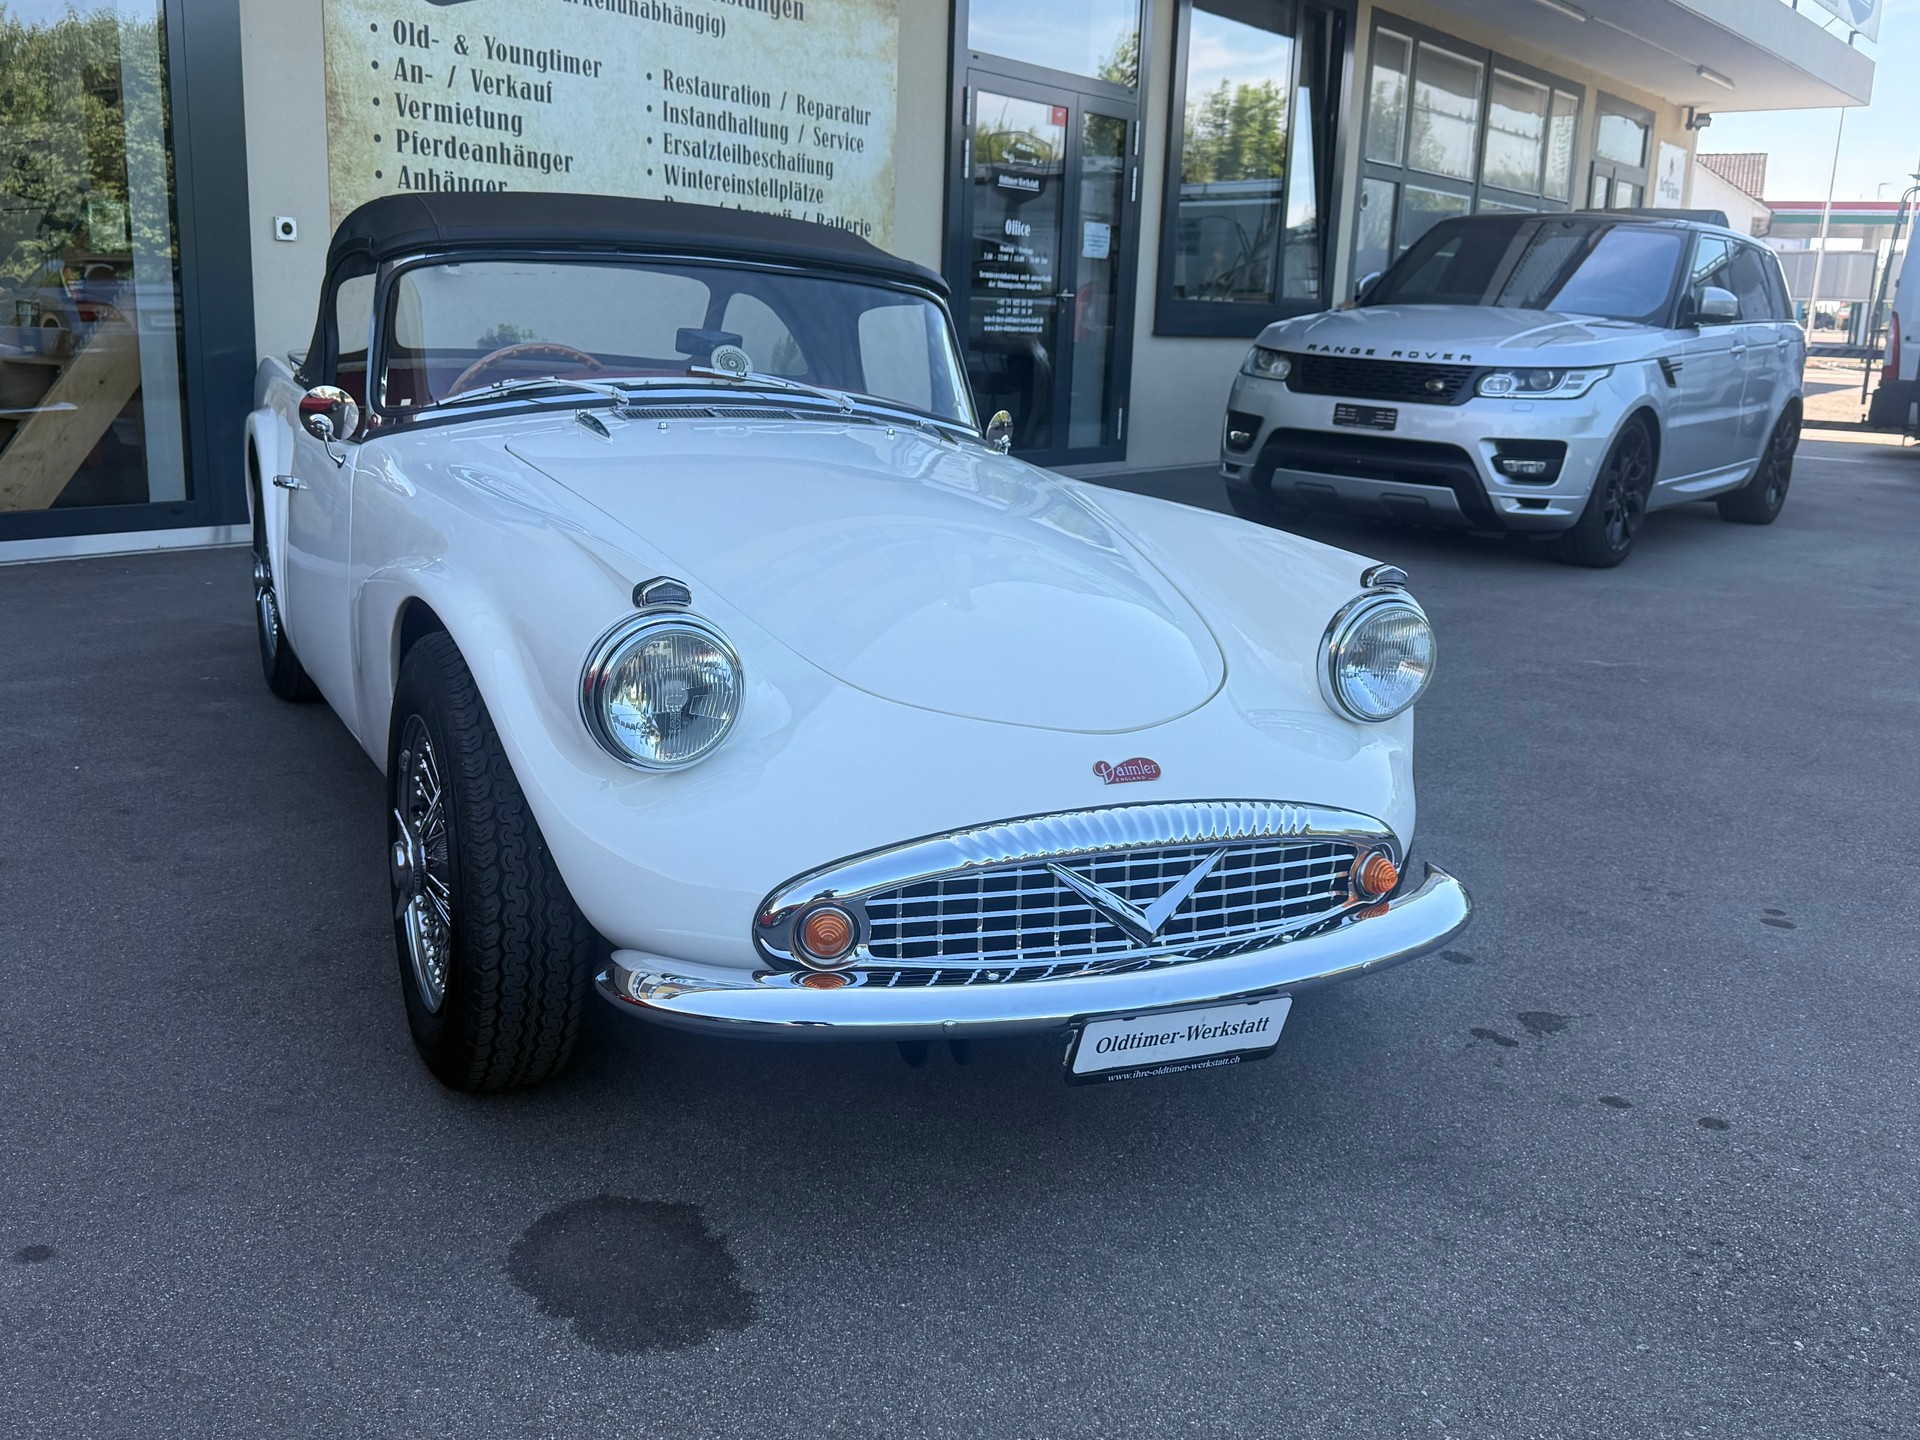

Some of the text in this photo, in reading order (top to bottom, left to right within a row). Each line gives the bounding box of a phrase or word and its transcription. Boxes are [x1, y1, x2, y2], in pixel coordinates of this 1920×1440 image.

[393, 19, 602, 79] Old- & Youngtimer
[394, 56, 553, 104] An- / Verkauf
[662, 68, 871, 126] Restauration / Reparatur
[394, 92, 523, 137] Vermietung
[662, 100, 864, 153] Instandhaltung / Service
[396, 128, 573, 174] Pferdeanhänger
[663, 132, 834, 181] Ersatzteilbeschaffung
[663, 163, 824, 204] Wintereinstellplätze
[1306, 343, 1472, 362] RANGE ROVER
[1094, 759, 1157, 784] Daimler
[1095, 1016, 1270, 1054] Oldtimer-Werkstatt
[1107, 1055, 1241, 1082] www.ihre-oldtimer-werkstatt.ch
